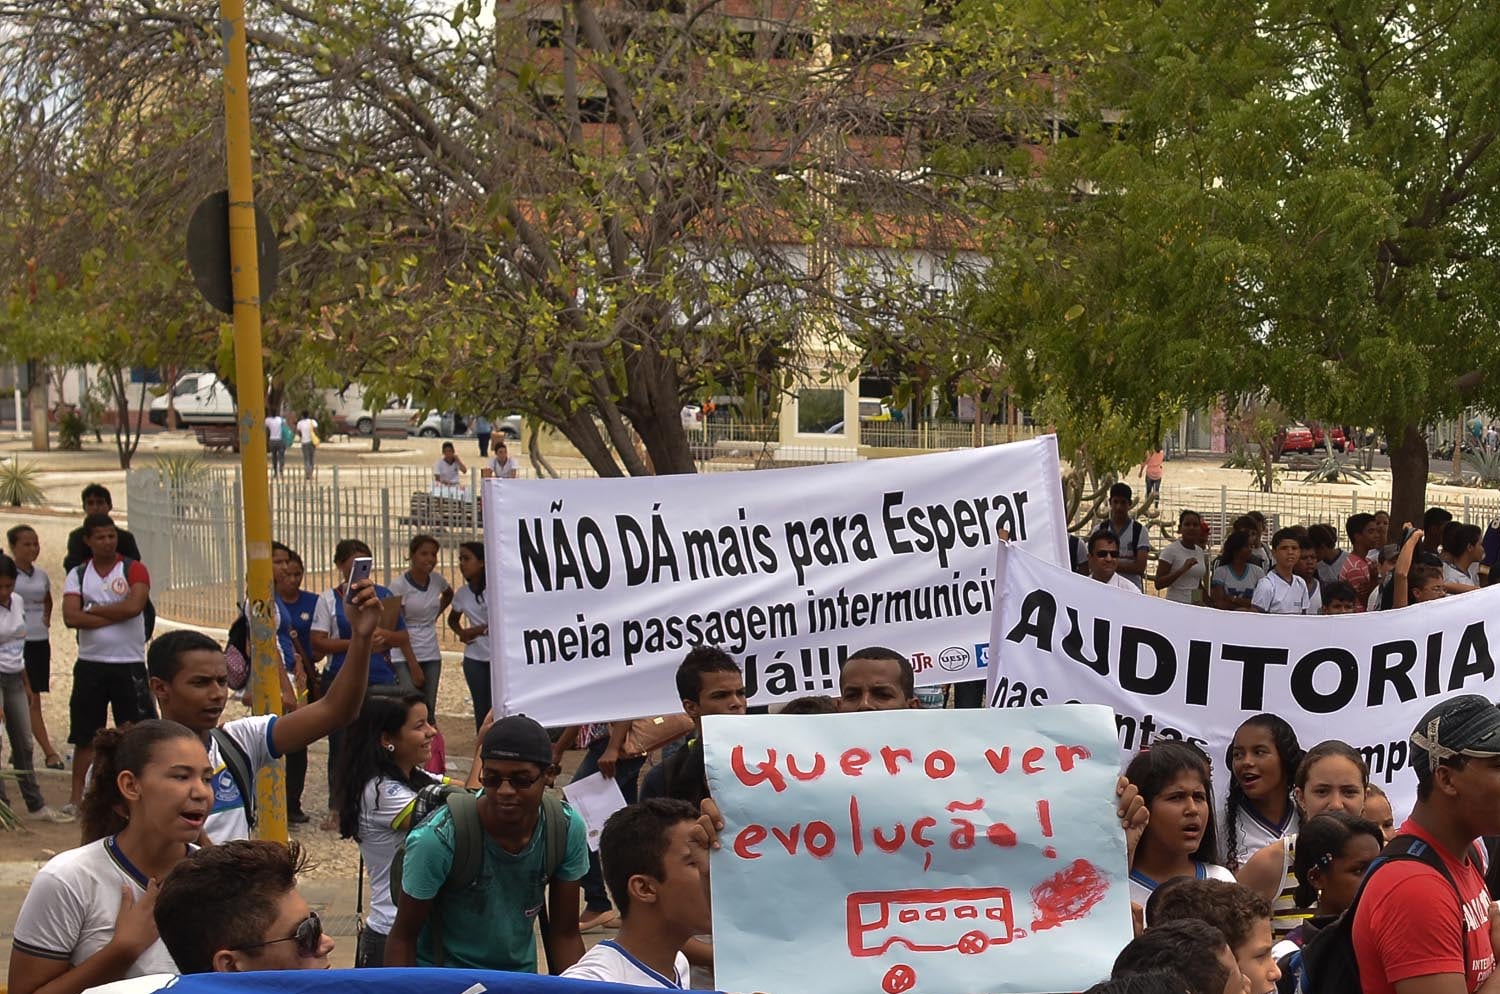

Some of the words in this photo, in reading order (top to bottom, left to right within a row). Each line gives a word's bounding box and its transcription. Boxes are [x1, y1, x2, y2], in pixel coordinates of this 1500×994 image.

[518, 499, 611, 593] NÃO
[615, 503, 680, 587] DÁ
[682, 508, 778, 581] mais
[785, 513, 878, 586] para
[882, 490, 1028, 569] Esperar
[524, 613, 611, 665] meia
[623, 601, 797, 666] passagem
[807, 567, 996, 634] intermunici
[1006, 588, 1495, 716] AUDITORIA
[984, 743, 1091, 776] ver
